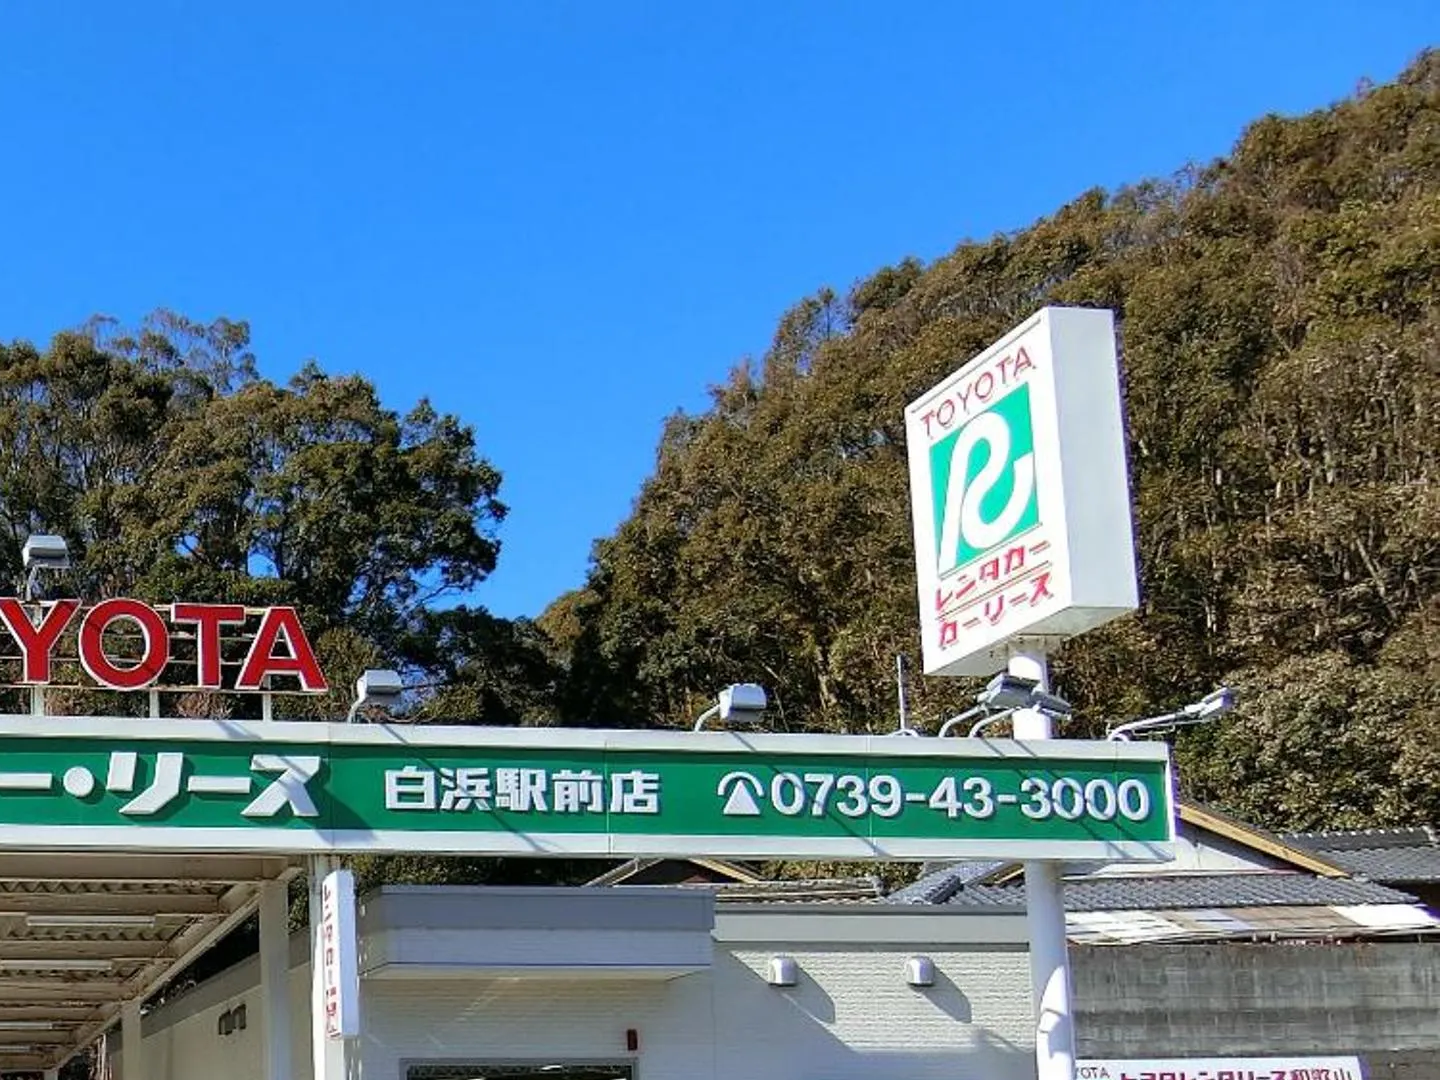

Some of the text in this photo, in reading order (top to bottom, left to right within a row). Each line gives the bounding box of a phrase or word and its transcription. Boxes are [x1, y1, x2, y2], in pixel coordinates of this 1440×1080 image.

[920, 346, 1035, 438] TOYOTA
[935, 540, 1051, 612] レンタカー
[938, 572, 1054, 650] カーリース
[383, 765, 660, 815] 白浜駅前店
[770, 772, 1150, 822] 0739-43-3000
